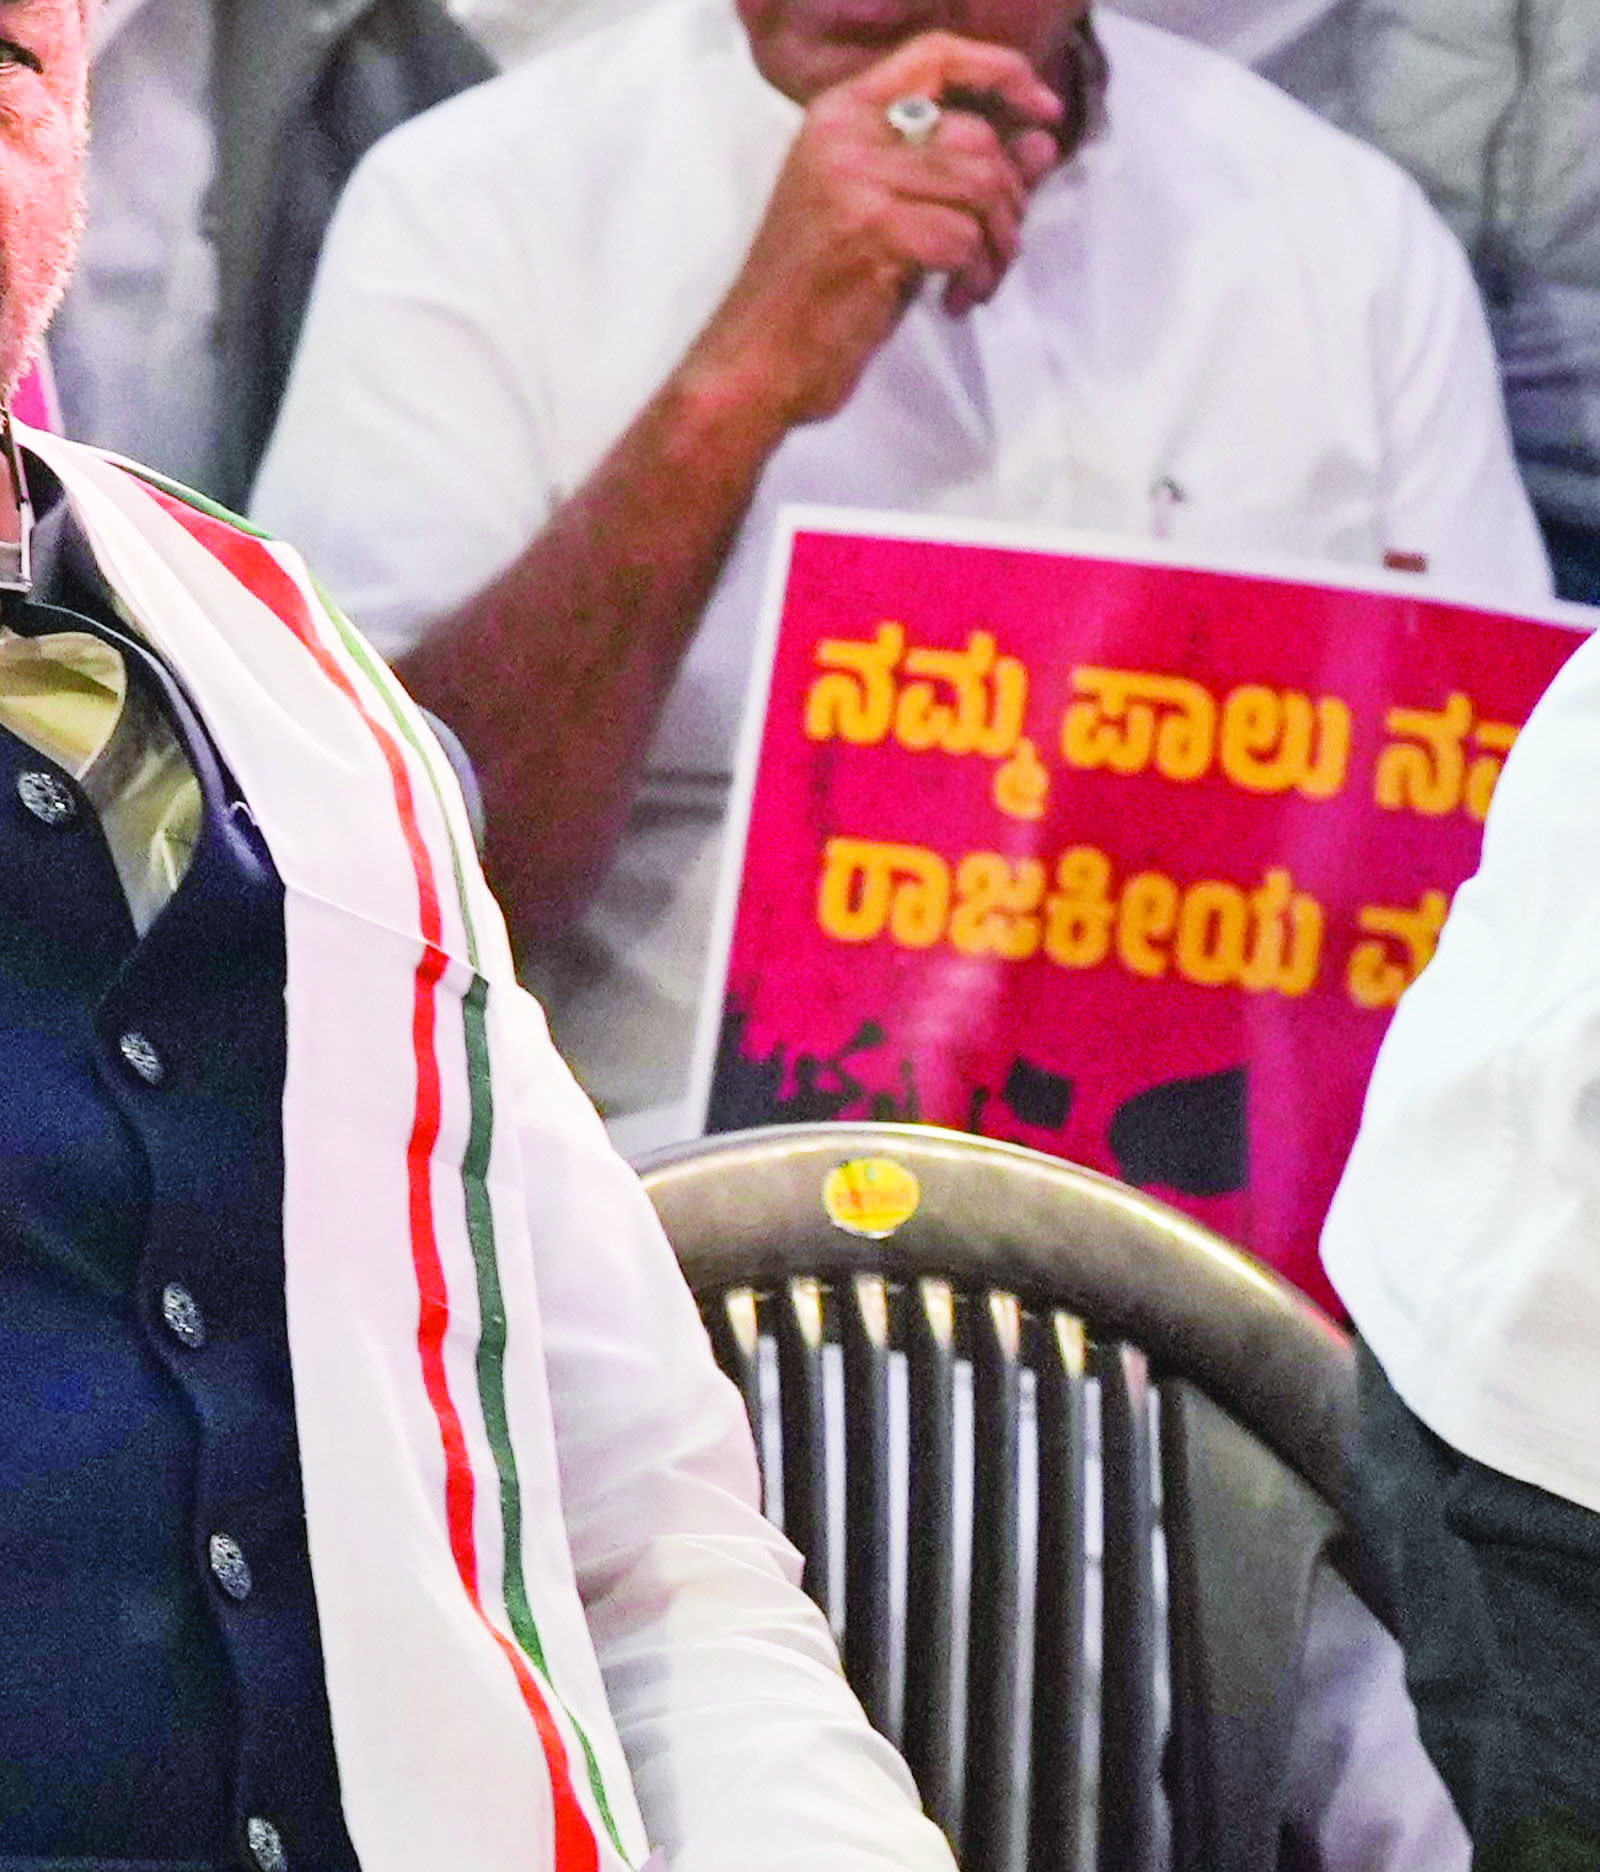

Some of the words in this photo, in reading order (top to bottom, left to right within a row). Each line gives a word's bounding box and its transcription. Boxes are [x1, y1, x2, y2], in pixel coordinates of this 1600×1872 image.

[806, 621, 1050, 820] ನಮ್ಮ
[1061, 666, 1352, 798] ಪಾಲು
[819, 836, 1323, 997] ರಾಜಕೀಯ
